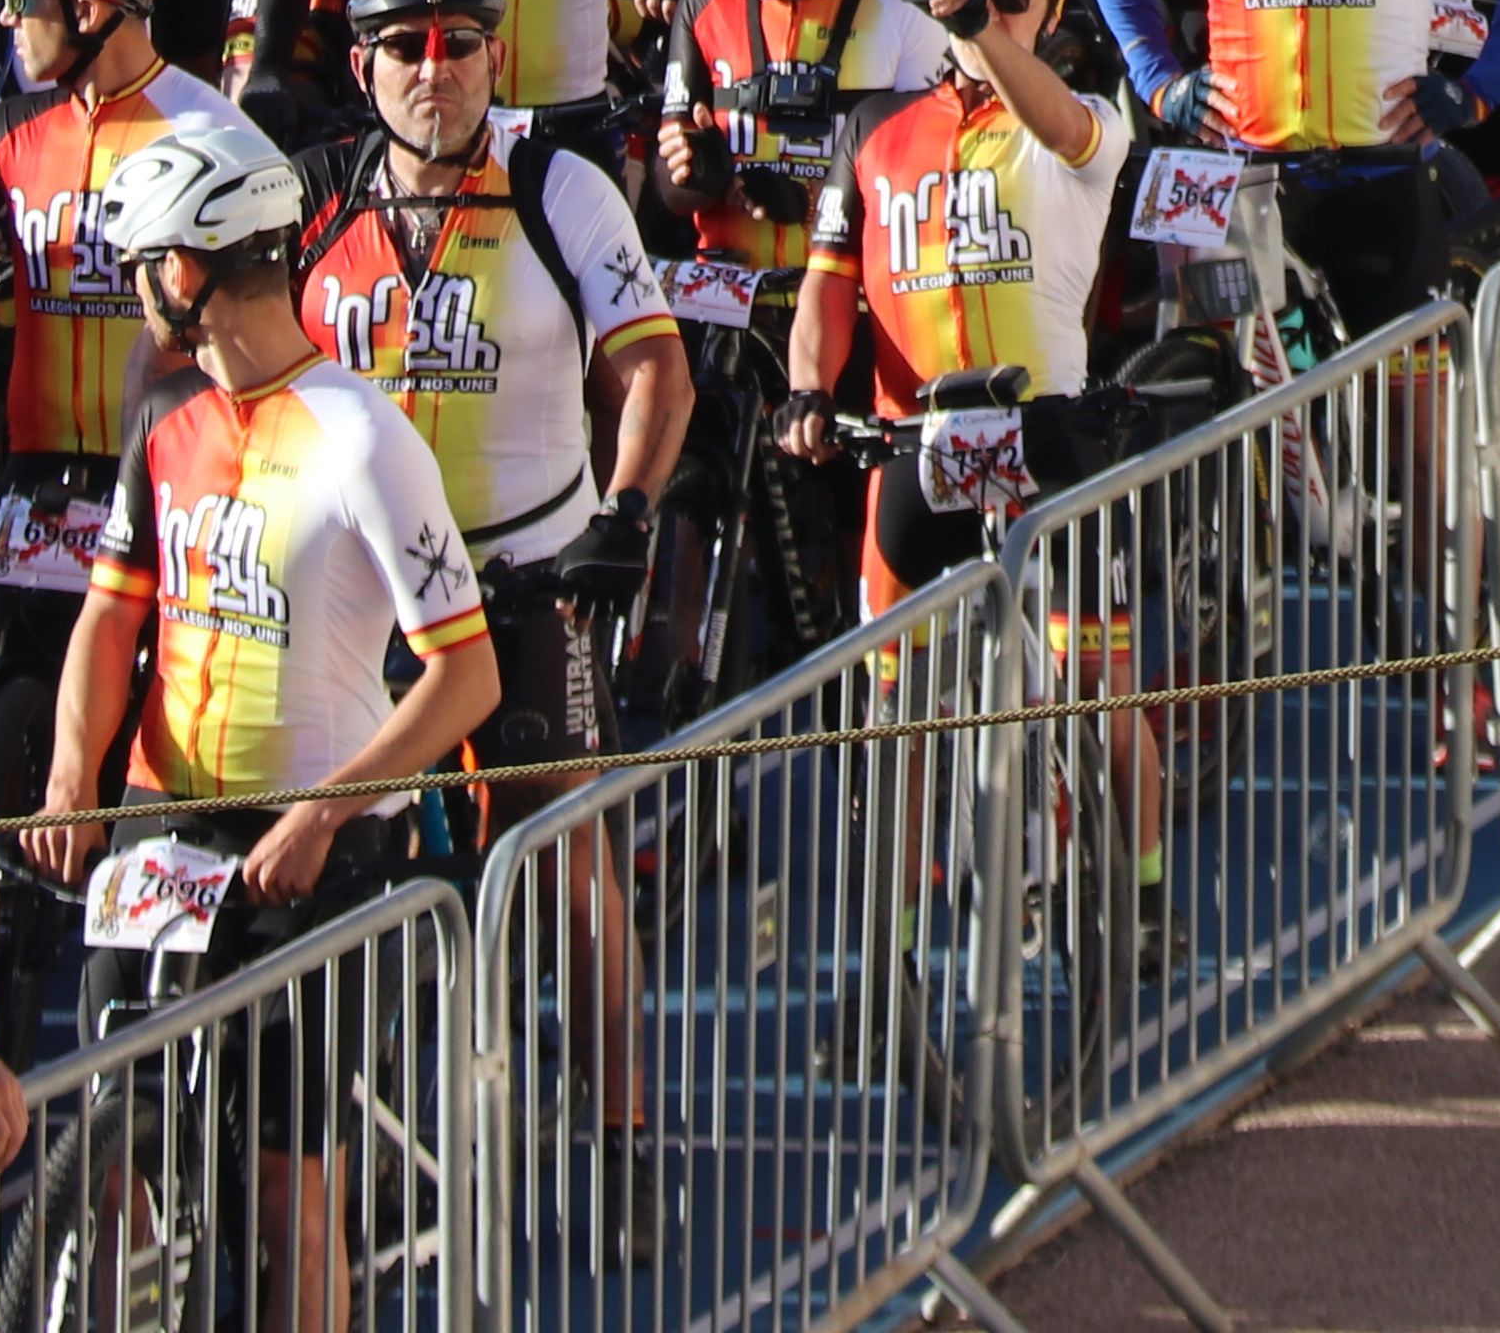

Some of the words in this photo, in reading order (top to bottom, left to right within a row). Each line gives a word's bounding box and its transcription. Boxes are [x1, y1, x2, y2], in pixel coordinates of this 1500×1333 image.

[1168, 181, 1232, 211] 5647
[944, 210, 1033, 267] 24h
[891, 278, 909, 296] LA
[963, 268, 997, 287] NOS
[999, 265, 1034, 284] UNE
[403, 320, 500, 373] 24h
[419, 376, 454, 393] NOS
[457, 376, 498, 393] UNE
[207, 551, 290, 623] 24h
[223, 615, 253, 640] NOS
[255, 625, 289, 648] UNE
[134, 871, 217, 912] 7696
